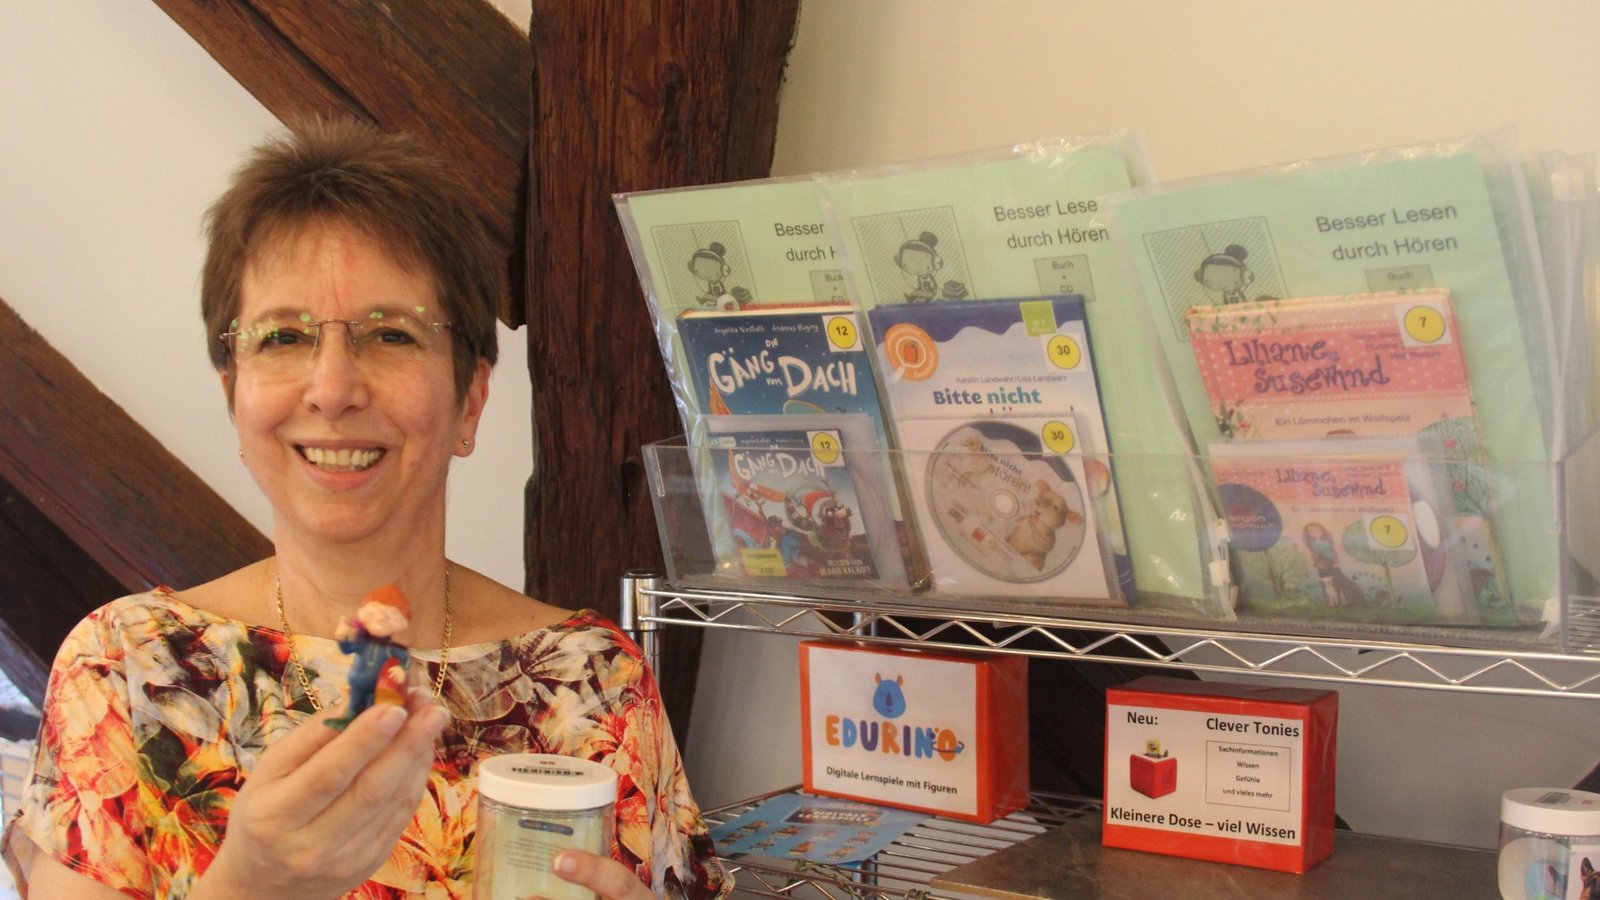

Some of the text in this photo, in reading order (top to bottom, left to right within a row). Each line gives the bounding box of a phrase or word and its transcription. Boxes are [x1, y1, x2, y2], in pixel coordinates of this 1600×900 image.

[993, 198, 1099, 222] Besser Lese
[1315, 204, 1458, 233] Besser Lesen
[774, 221, 825, 237] Besser
[1007, 226, 1110, 250] durch Hören
[786, 246, 826, 262] durch
[1332, 235, 1458, 261] durch Hören
[1051, 260, 1074, 271] Buch
[1387, 270, 1414, 281] Buch
[1419, 316, 1427, 328] 7
[834, 325, 849, 336] 12
[765, 337, 780, 348] DIE
[1056, 344, 1071, 356] 30
[708, 347, 775, 394] GÄNG
[777, 355, 857, 398] DACH
[933, 387, 1042, 405] Bitte nicht
[1275, 417, 1291, 426] Ein
[1348, 415, 1360, 424] im
[1050, 430, 1065, 441] 30
[1383, 525, 1391, 535] 7
[1127, 711, 1158, 726] Neu:
[1206, 717, 1300, 737] Clever Tonies
[825, 714, 960, 762] EDURINO
[1218, 745, 1279, 758] Sachinformationen
[1236, 761, 1260, 770] Wissen
[826, 766, 958, 795] Digitale Lernspiele mit Figuren
[1235, 774, 1261, 784] Gefühle
[1222, 788, 1273, 799] und vieles mehr
[1110, 807, 1165, 824] Kleinere
[1168, 813, 1202, 829] Dose
[1217, 819, 1242, 834] viel
[1246, 821, 1296, 840] Wissen
